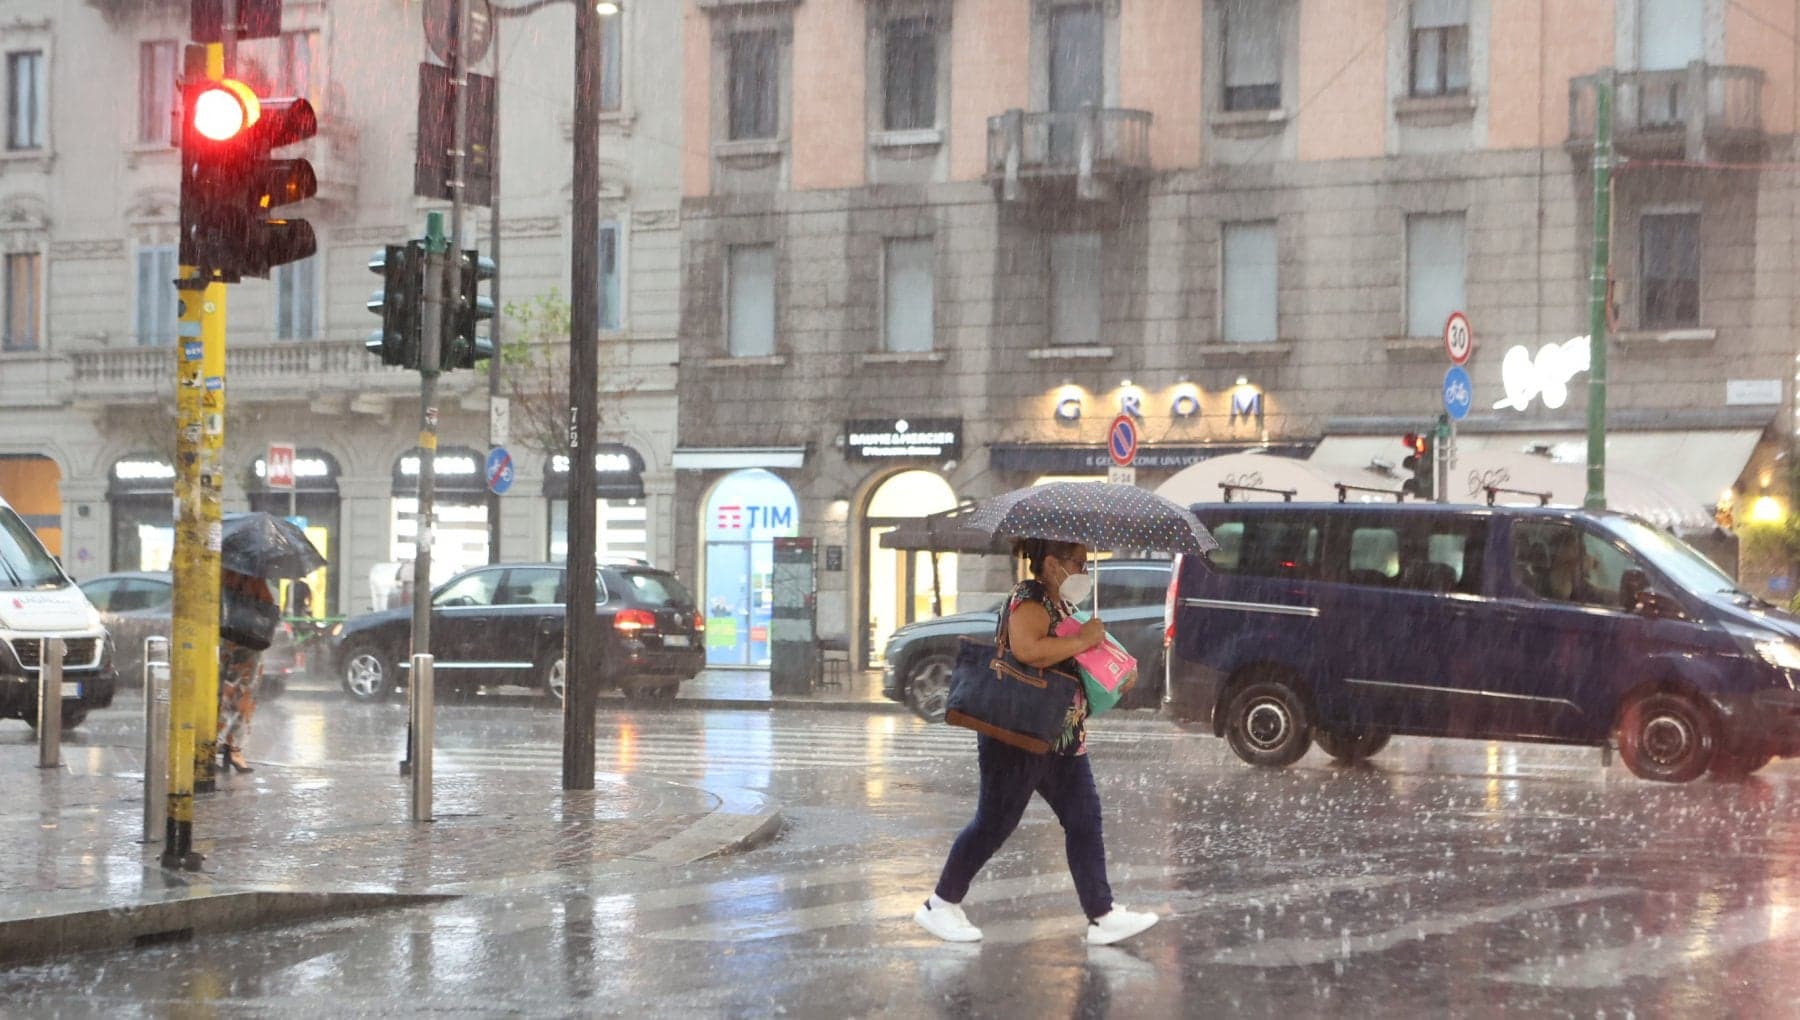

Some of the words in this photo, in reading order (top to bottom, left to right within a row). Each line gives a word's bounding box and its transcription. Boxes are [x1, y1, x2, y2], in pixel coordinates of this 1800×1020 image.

[1450, 325, 1466, 350] 30
[1056, 393, 1263, 420] GROM
[1133, 456, 1158, 467] COME
[1160, 455, 1181, 466] UNA
[746, 506, 792, 529] TIM
